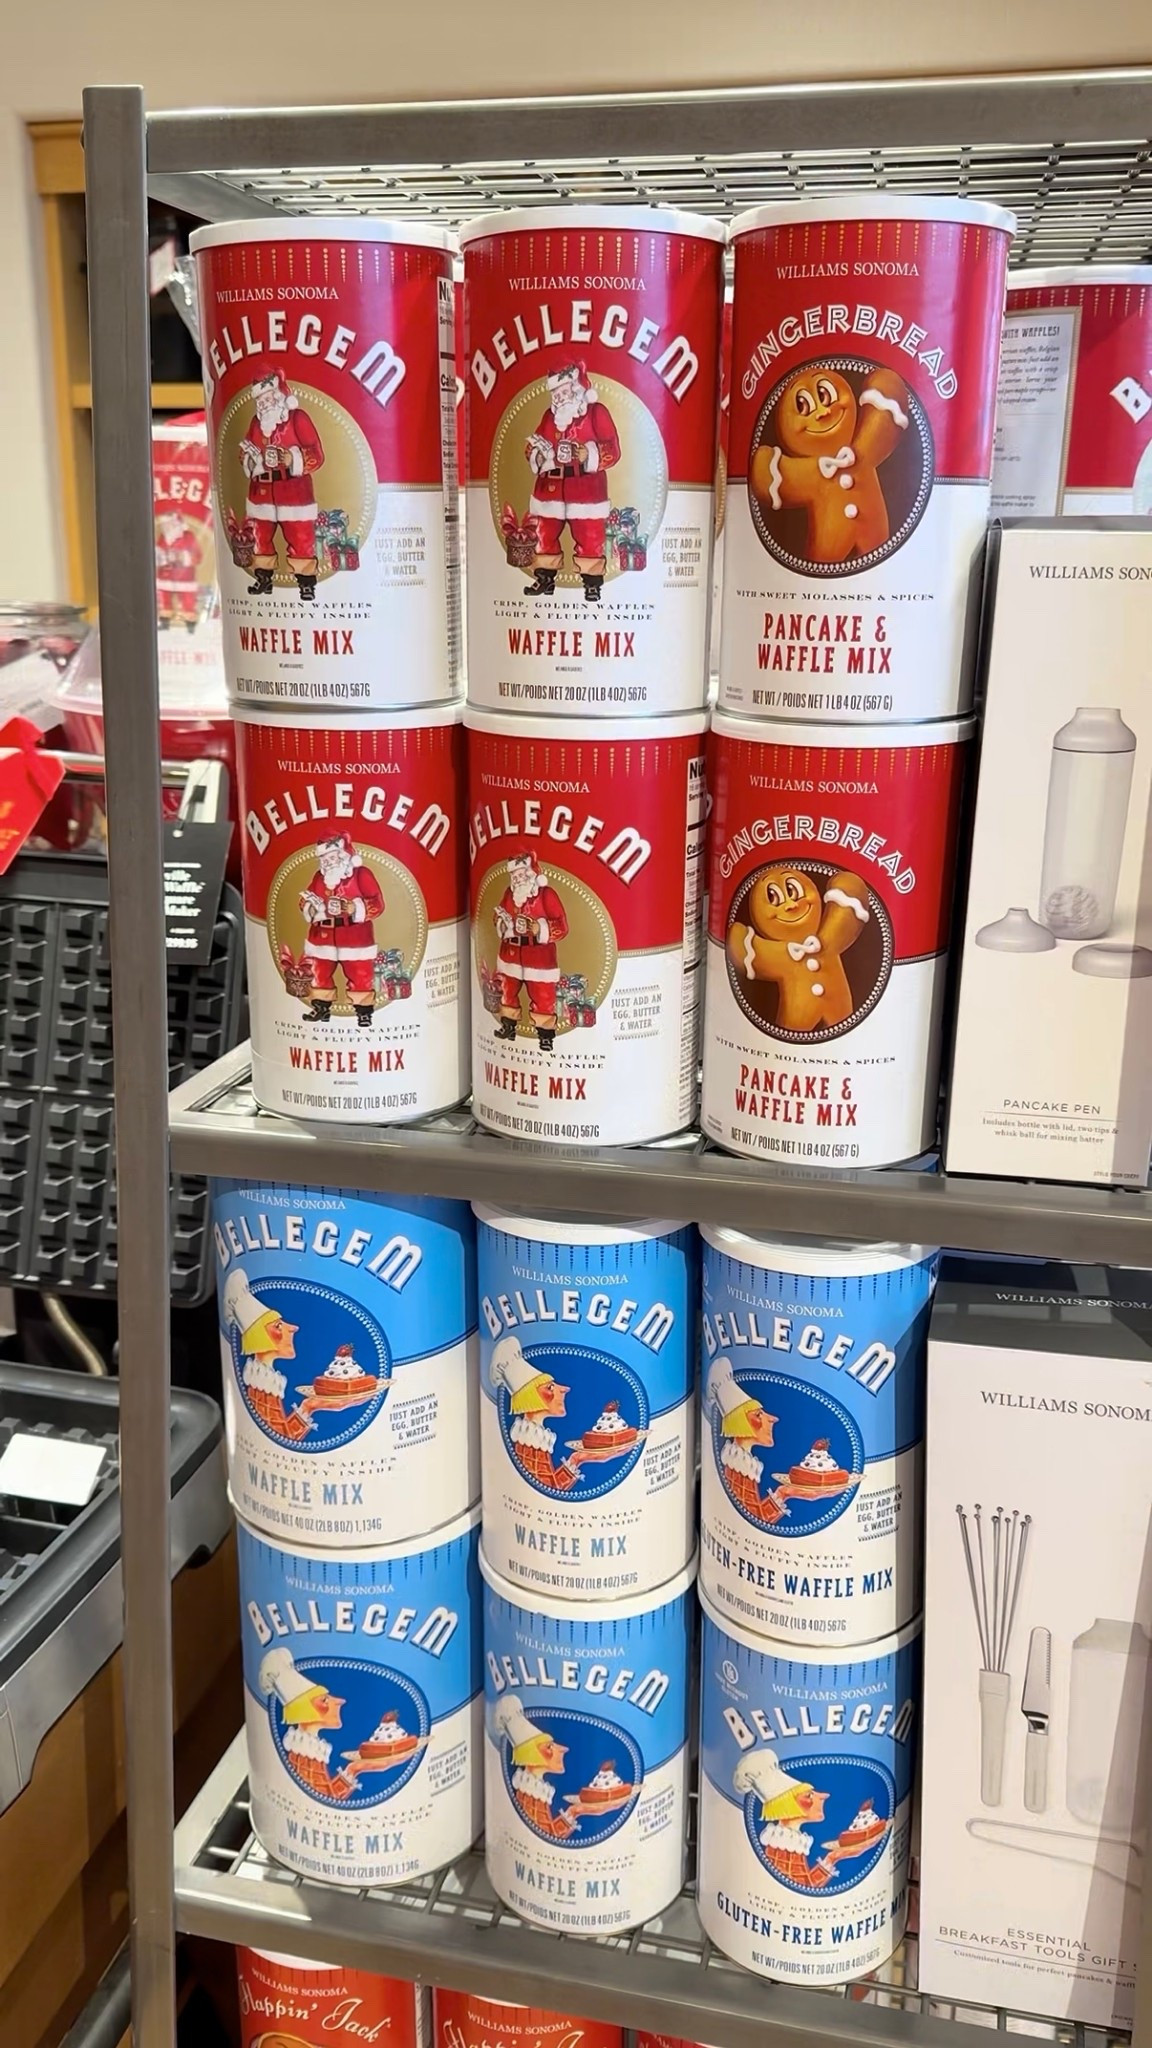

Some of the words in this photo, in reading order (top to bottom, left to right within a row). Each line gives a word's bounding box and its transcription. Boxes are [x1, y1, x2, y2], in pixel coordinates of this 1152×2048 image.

[509, 277, 579, 291] WILLIAMS
[584, 276, 646, 290] SONOMA
[777, 263, 848, 279] WILLIAMS
[853, 262, 919, 276] SONOMA
[216, 288, 273, 303] WILLIAMS
[277, 287, 339, 300] SONOMA
[471, 300, 699, 402] BELLEGEM
[742, 304, 958, 401] GINGERBREAD
[1029, 565, 1114, 580] WILLIAMS
[1118, 567, 1152, 580] SON
[736, 589, 757, 598] WITH
[760, 592, 797, 600] SWEET
[802, 593, 872, 602] MOLASSES
[891, 593, 935, 601] SPICES
[239, 626, 302, 655] WAFFLE
[313, 630, 354, 655] MIX
[763, 613, 862, 642] PANCAKE
[875, 616, 886, 642] &
[508, 628, 582, 657] WAFFLE
[595, 632, 635, 658] MIX
[757, 644, 835, 673] WAFFLE
[847, 647, 892, 674] MIX
[499, 682, 510, 697] NET
[548, 686, 563, 700] NET
[753, 690, 764, 704] NET
[808, 694, 825, 709] NET
[278, 760, 341, 773] WILLIAMS
[345, 763, 400, 774] SONOMA
[481, 772, 531, 790] WILLIAMS
[533, 780, 590, 793] SONOMA
[749, 774, 814, 793] WILLIAMS
[818, 780, 879, 794] SONOMA
[246, 783, 451, 857] BELLEGEM
[718, 814, 916, 895] GINGERBREAD
[611, 997, 630, 1009] JUST
[633, 995, 649, 1006] ADD
[651, 993, 662, 1004] AN
[633, 1006, 661, 1018] BUTTER
[627, 1019, 652, 1031] WATER
[290, 1046, 357, 1073] WAFFLE
[369, 1049, 404, 1073] MIX
[485, 1061, 539, 1097] WAFFLE
[549, 1076, 586, 1100] MIX
[740, 1063, 830, 1099] PANCAKE
[841, 1077, 852, 1100] &
[735, 1088, 805, 1124] WAFFLE
[817, 1104, 857, 1127] MIX
[1003, 1099, 1069, 1113] PANCAKE
[1074, 1104, 1101, 1114] PEN
[982, 1117, 1015, 1127] Includes
[1017, 1120, 1041, 1129] bottle
[1042, 1122, 1061, 1131] with
[1095, 1125, 1110, 1135] tips
[994, 1129, 1017, 1138] whisk
[1019, 1131, 1034, 1139] ball
[1036, 1132, 1047, 1140] for
[1050, 1134, 1078, 1143] mixing
[1079, 1135, 1104, 1144] batter
[238, 1188, 290, 1207] WILLIAMS
[293, 1198, 346, 1210] SONOMA
[213, 1214, 423, 1294] BELLEGEM
[512, 1265, 571, 1285] WILLIAMS
[575, 1274, 629, 1286] SONOMA
[726, 1284, 783, 1312] WILLIAMS
[787, 1304, 845, 1318] SONOMA
[995, 1292, 1083, 1306] WILLIAMS
[482, 1290, 675, 1355] BELLEGEM
[702, 1311, 896, 1398] BELLEGEM
[389, 1410, 407, 1422] JUST
[410, 1405, 427, 1416] ADD
[428, 1400, 439, 1411] AN
[411, 1412, 438, 1427] BUTTER
[980, 1390, 1078, 1414] WILLIAMS
[1084, 1402, 1152, 1422] SONOM
[406, 1425, 430, 1439] WATER
[248, 1462, 311, 1503] WAFFLE
[323, 1483, 363, 1505] MIX
[856, 1501, 874, 1513] JUST
[876, 1496, 891, 1508] ADD
[893, 1491, 903, 1502] AN
[876, 1503, 901, 1519] BUTTER
[870, 1518, 894, 1531] WATER
[515, 1523, 580, 1557] WAFFLE
[591, 1535, 627, 1558] MIX
[286, 1576, 341, 1595] WILLIAMS
[344, 1583, 394, 1596] SONOMA
[784, 1573, 854, 1598] WAFFLE
[862, 1567, 893, 1594] MIX
[248, 1600, 458, 1659] BELLEGEM
[515, 1631, 571, 1656] WILLIAMS
[574, 1646, 625, 1659] SONOMA
[486, 1651, 670, 1717] BELLEGEM
[772, 1683, 837, 1701] WILLIAMS
[841, 1681, 889, 1699] SONOMA
[286, 1818, 354, 1855] WAFFLE
[365, 1831, 404, 1855] MIX
[515, 1860, 576, 1897] WAFFLE
[586, 1878, 620, 1898] MIX
[717, 1891, 823, 1945] GLUTEN-FREE
[831, 1908, 887, 1944] WAFFLE
[939, 1926, 1029, 1951] BREAKFAST
[1034, 1944, 1086, 1962] TOOLS
[1092, 1956, 1127, 1970] GIFT
[1007, 1927, 1091, 1951] ESSENTIAL
[953, 1949, 1000, 1964] Customized
[1001, 1959, 1021, 1968] tools
[1037, 1965, 1065, 1976] perfect
[1067, 1971, 1104, 1983] pancakes
[251, 1967, 299, 1995] WILLIAMS
[301, 1986, 348, 1997] SONOMA
[322, 1998, 391, 2043] Jack
[467, 2011, 522, 2034] WILLIAMS
[525, 2020, 573, 2035] SONOMA
